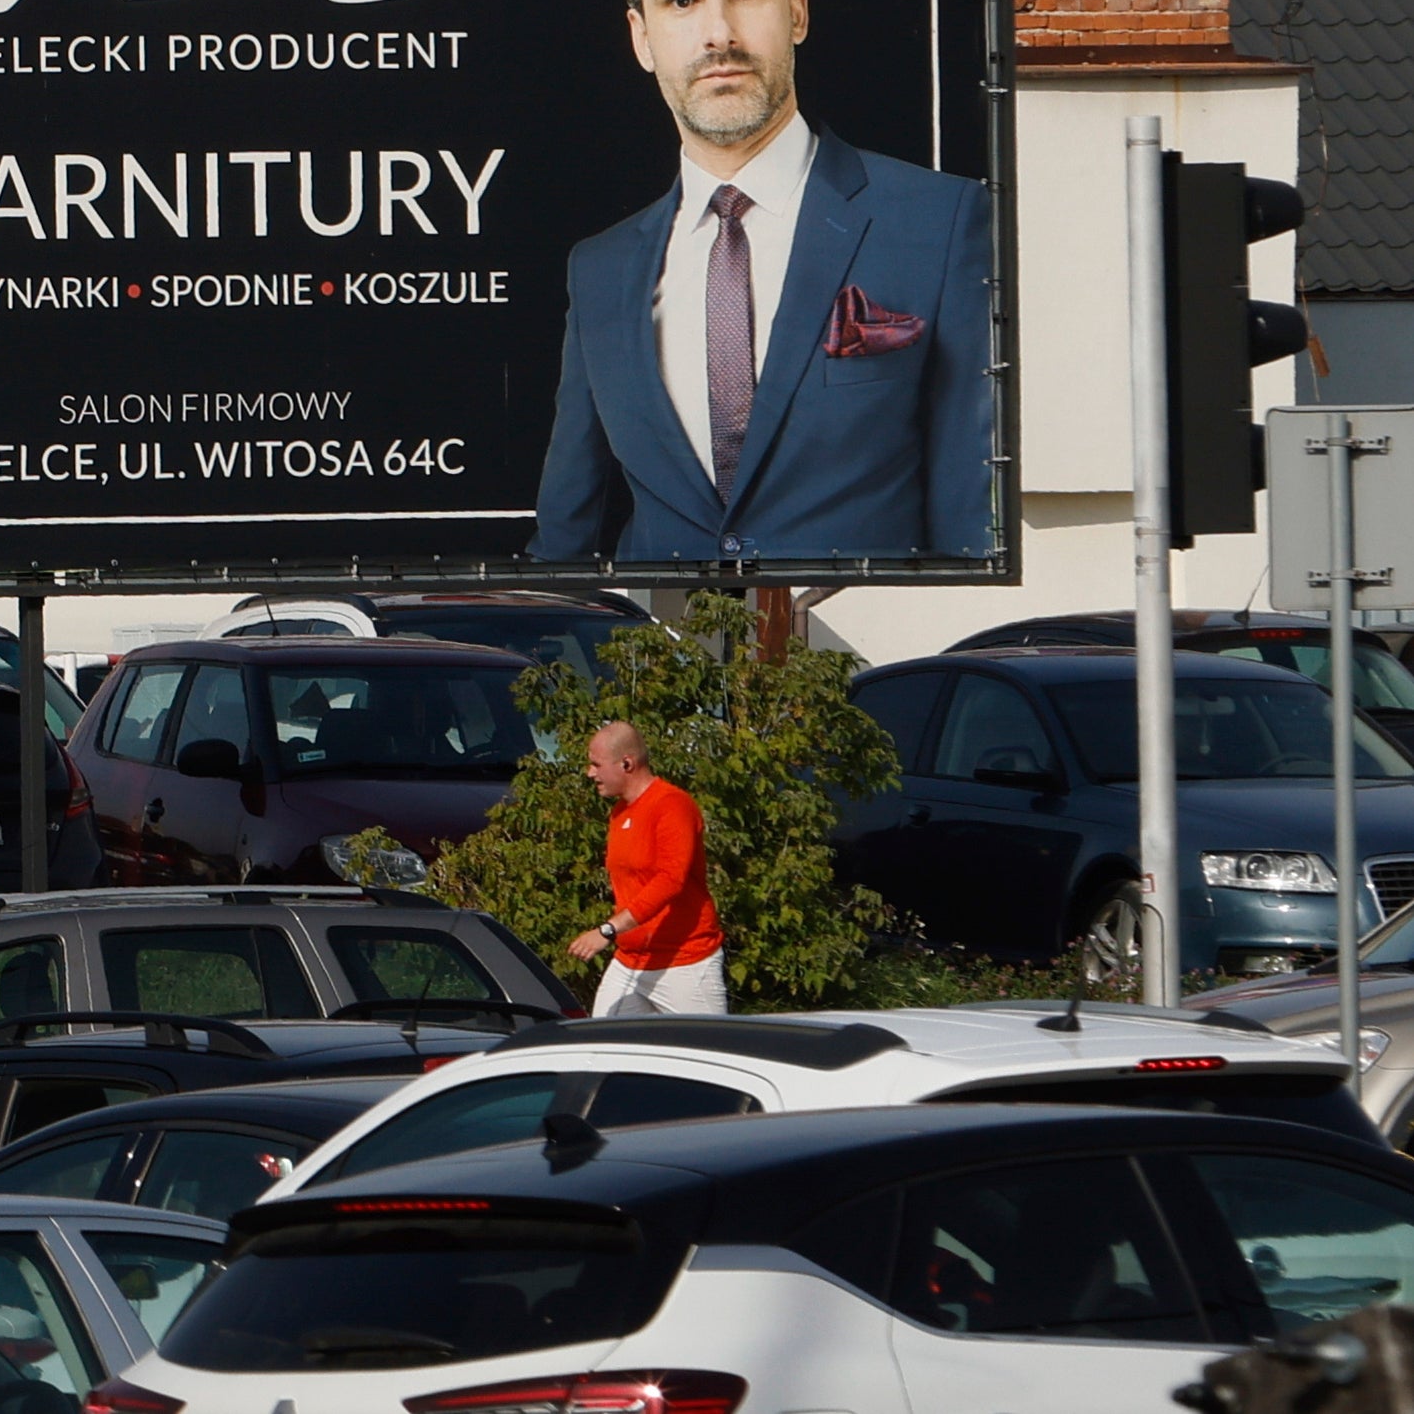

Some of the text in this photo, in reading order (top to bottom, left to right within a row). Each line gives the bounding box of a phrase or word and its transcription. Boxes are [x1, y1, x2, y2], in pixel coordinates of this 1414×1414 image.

[168, 32, 469, 72] PRODUCENT
[150, 273, 314, 308] SPODNIE
[345, 271, 510, 306] KOSZULE
[58, 390, 354, 426] SALON FIRMOWY
[120, 442, 187, 480] UL.
[194, 440, 375, 479] WITOSA
[383, 438, 466, 476] 64C
